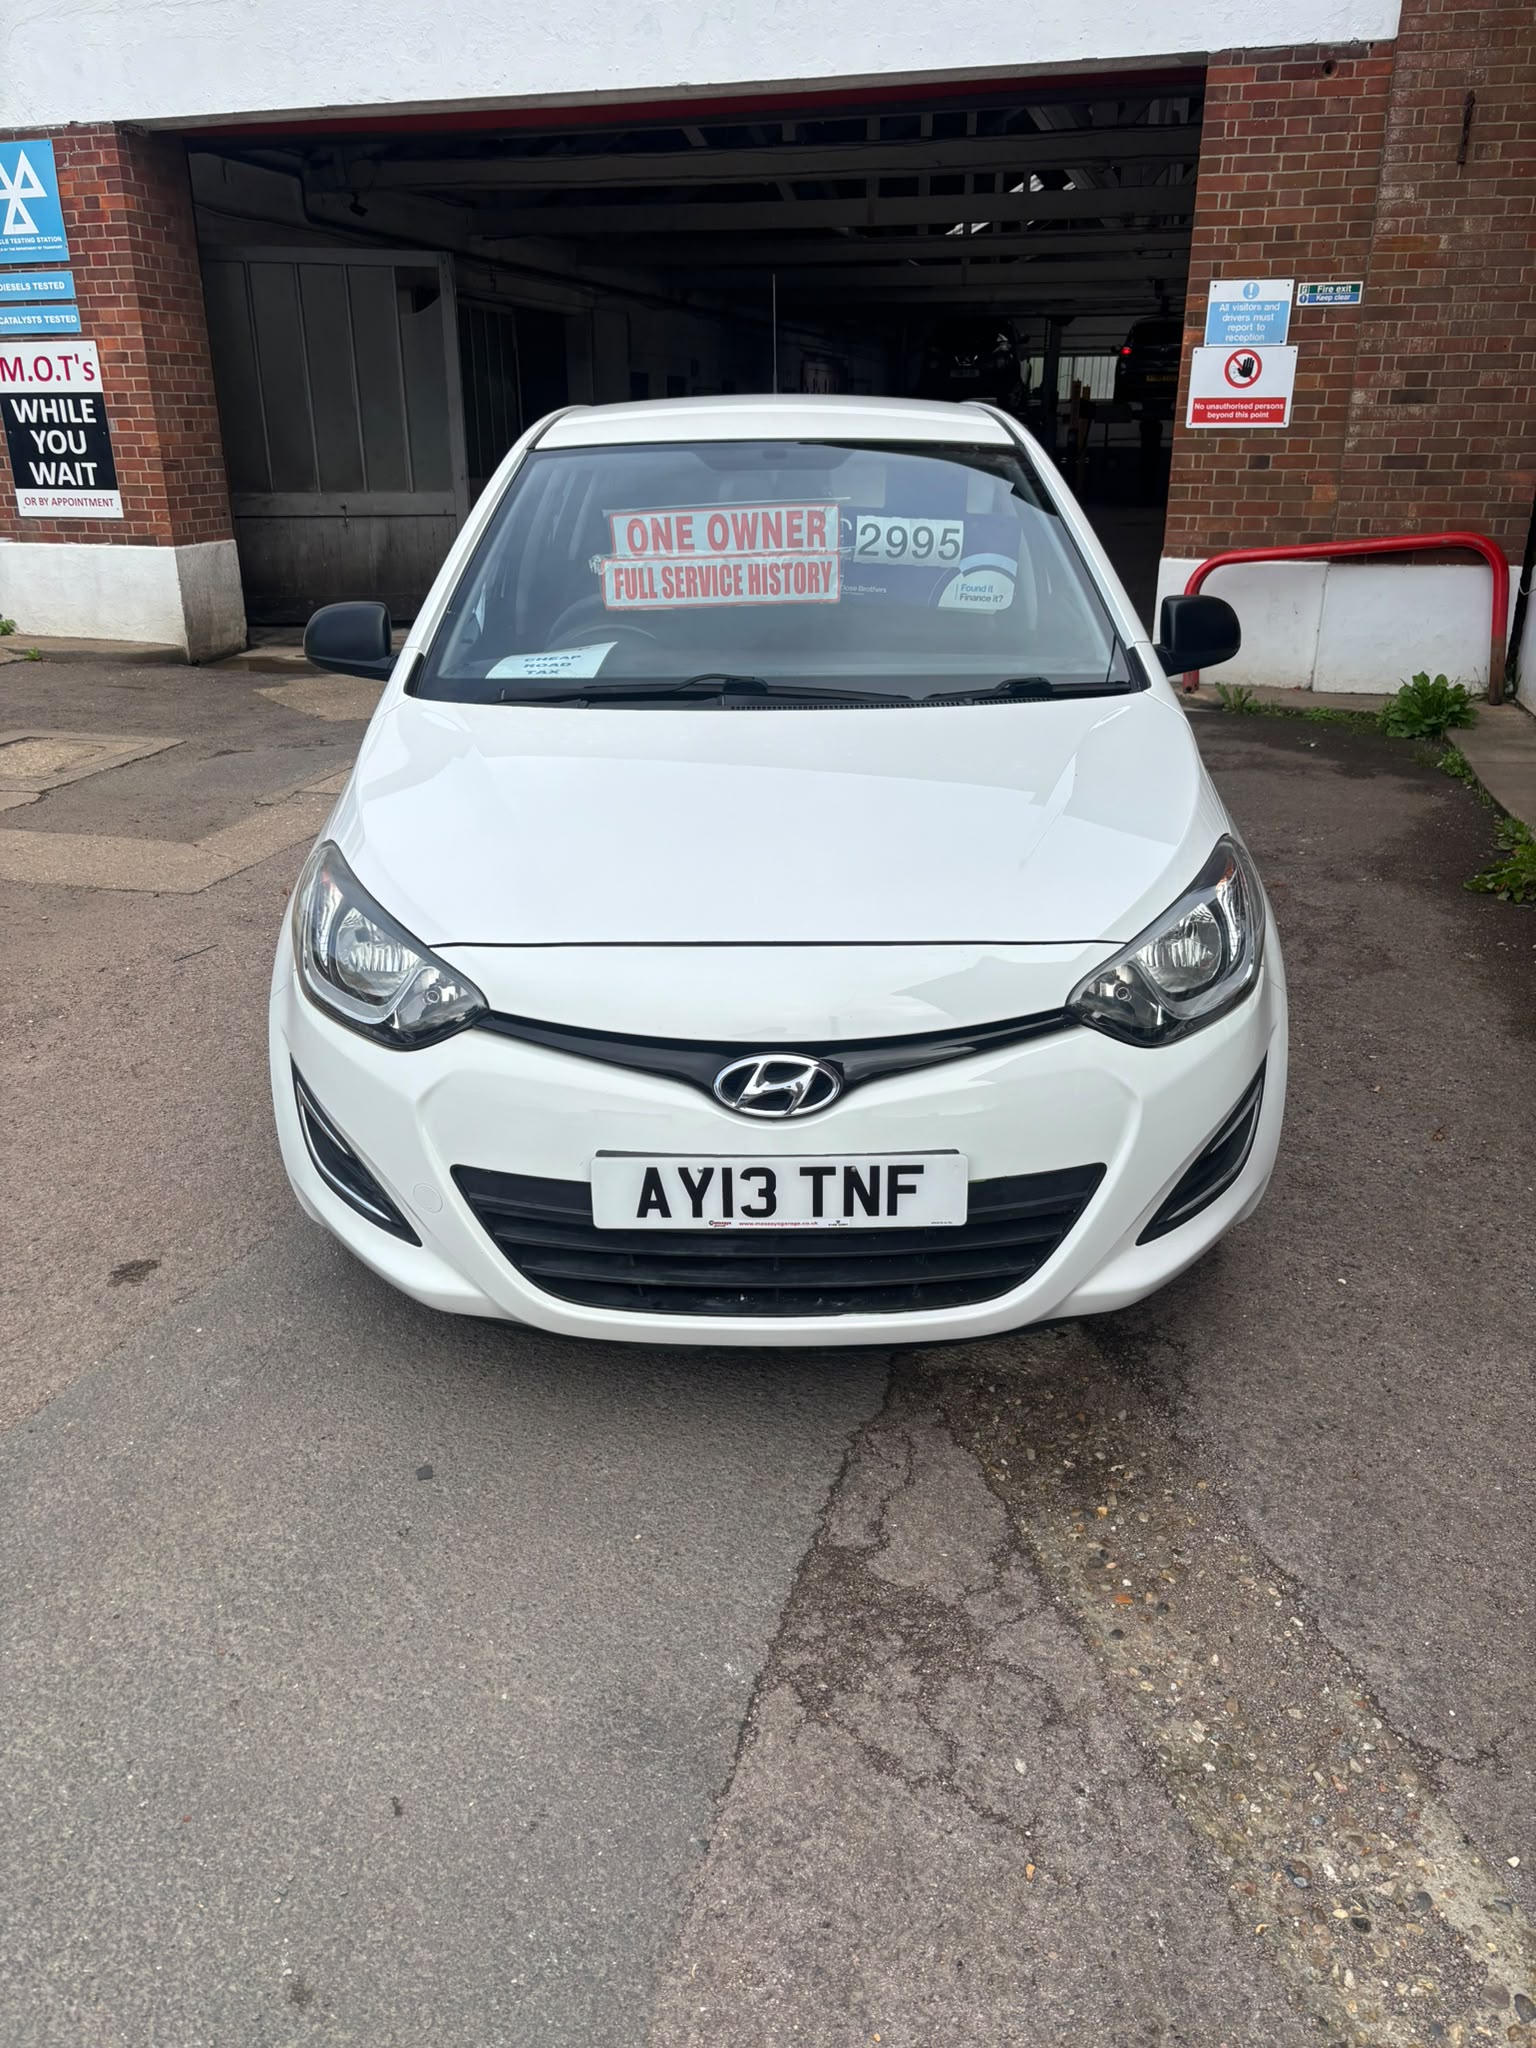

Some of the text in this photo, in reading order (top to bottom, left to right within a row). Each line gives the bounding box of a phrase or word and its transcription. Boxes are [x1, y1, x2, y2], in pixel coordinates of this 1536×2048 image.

[32, 281, 65, 290] TESTED
[1317, 284, 1352, 293] Fire exit
[1316, 293, 1350, 302] Keep clear
[1219, 303, 1280, 312] All visitors and
[0, 314, 77, 325] CATALYSTS TESTED
[1222, 313, 1274, 322] drivers must
[1227, 323, 1265, 332] report to
[1225, 333, 1265, 343] reception
[0, 353, 95, 382] M.O.T's
[10, 399, 97, 423] WHILE
[1206, 402, 1253, 410] unauthorised
[1254, 403, 1284, 412] persons
[1207, 411, 1269, 420] beyond this point
[30, 430, 87, 455] YOU
[29, 462, 97, 486] WAIT
[24, 497, 114, 507] OR BY APPOINTMENT
[626, 510, 827, 557] ONE OWNER
[857, 522, 961, 561] 2995
[614, 561, 833, 601] FULL SERVICE HISTORY
[960, 584, 993, 593] Found it
[960, 594, 1003, 603] Finance it?
[636, 1164, 925, 1219] AY13 TNF
